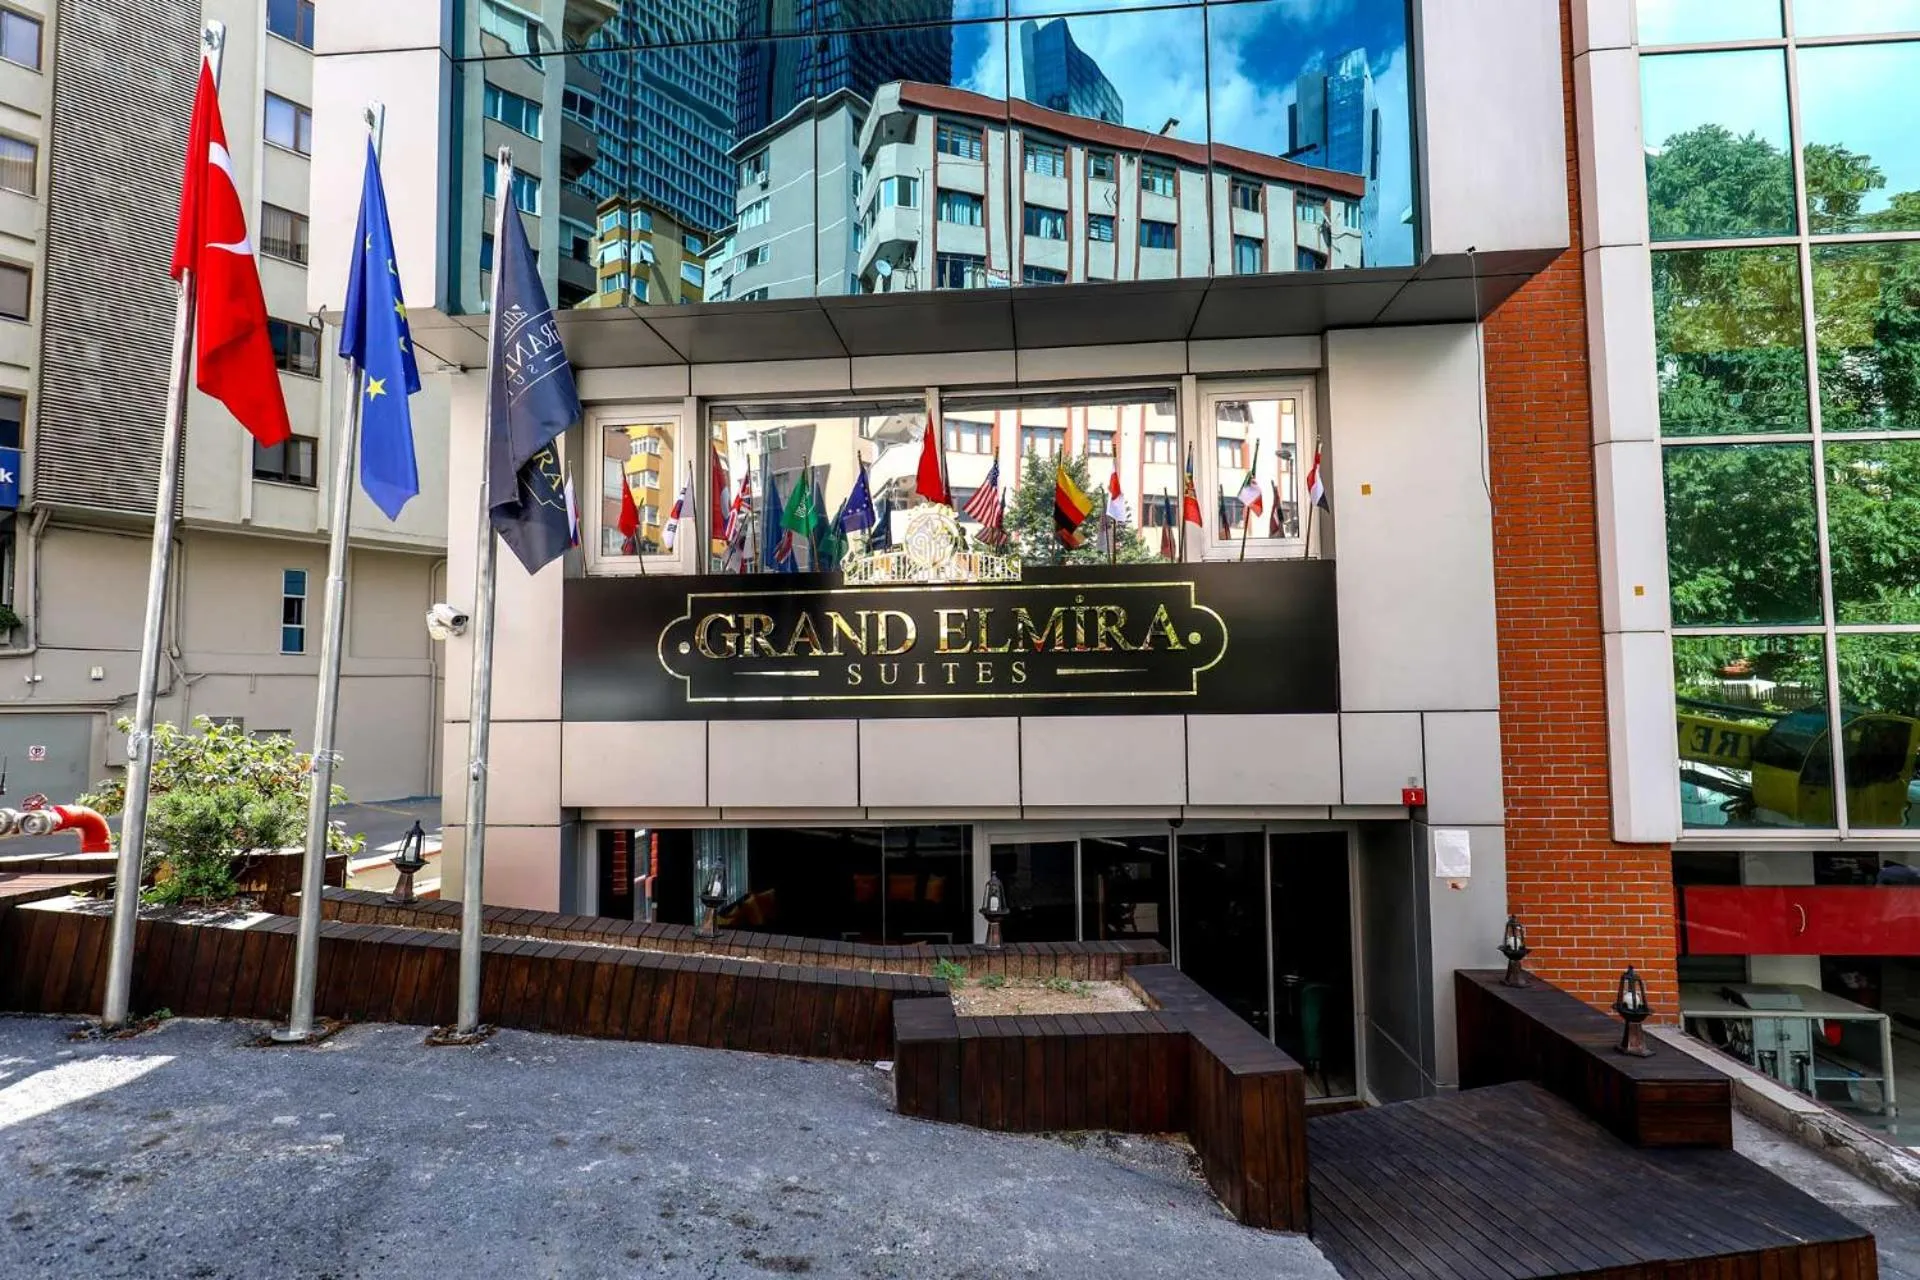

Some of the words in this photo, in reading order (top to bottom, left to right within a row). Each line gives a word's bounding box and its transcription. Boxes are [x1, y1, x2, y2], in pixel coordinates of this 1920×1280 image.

[695, 611, 918, 659] GRAND
[934, 595, 1187, 655] ELMİRA
[848, 661, 1028, 686] SUITES
